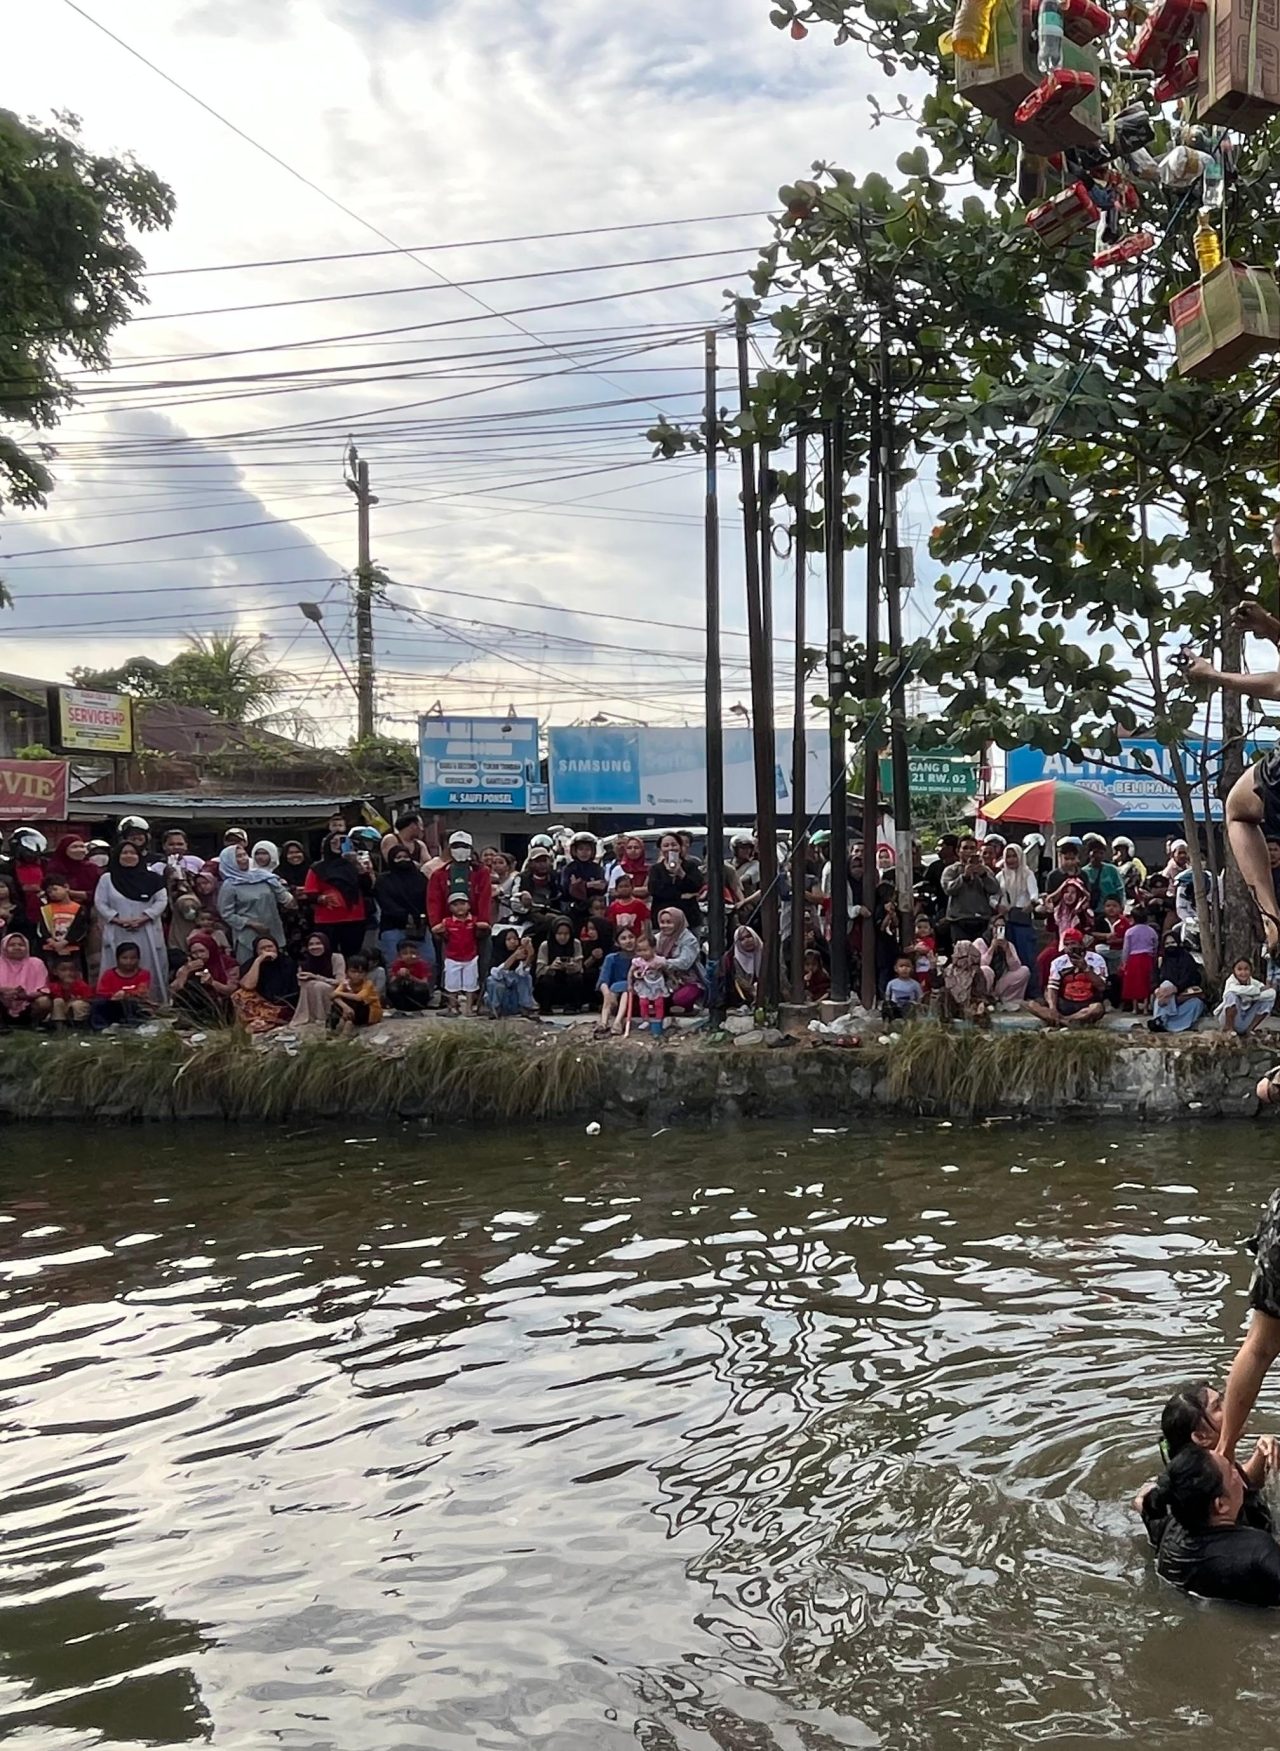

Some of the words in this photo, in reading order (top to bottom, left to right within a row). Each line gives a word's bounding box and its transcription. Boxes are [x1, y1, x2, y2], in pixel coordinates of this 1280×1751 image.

[68, 707, 111, 725] SERVICE
[111, 712, 125, 726] HP
[558, 759, 632, 772] SAMSUNG
[908, 762, 940, 772] GANG
[912, 773, 925, 783] 21
[952, 774, 967, 784] 02
[0, 770, 56, 801] VIE
[1116, 782, 1143, 794] BELI
